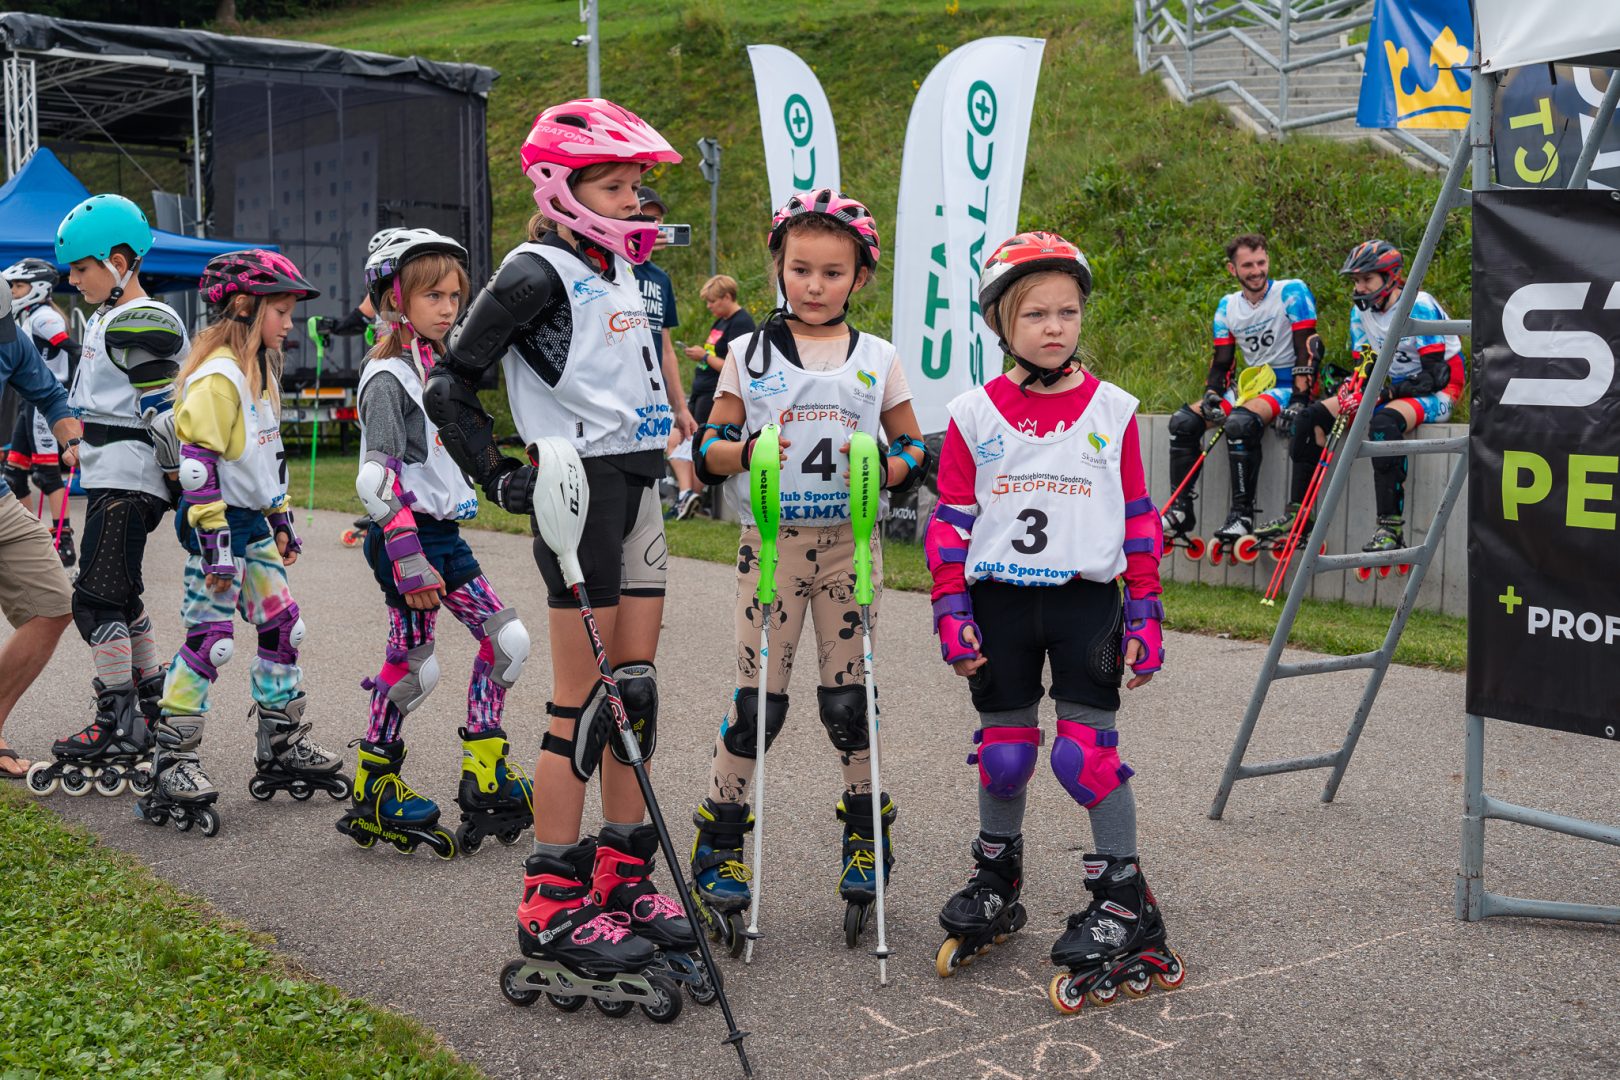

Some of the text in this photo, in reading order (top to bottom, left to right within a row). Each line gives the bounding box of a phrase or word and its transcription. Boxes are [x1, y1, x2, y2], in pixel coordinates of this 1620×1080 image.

[1245, 329, 1274, 352] 36
[1500, 282, 1620, 407] S
[801, 438, 837, 481] 4
[1008, 472, 1059, 482] Przedsiębiorstwo
[780, 491, 850, 503] lub Sporto
[1011, 508, 1048, 555] 3
